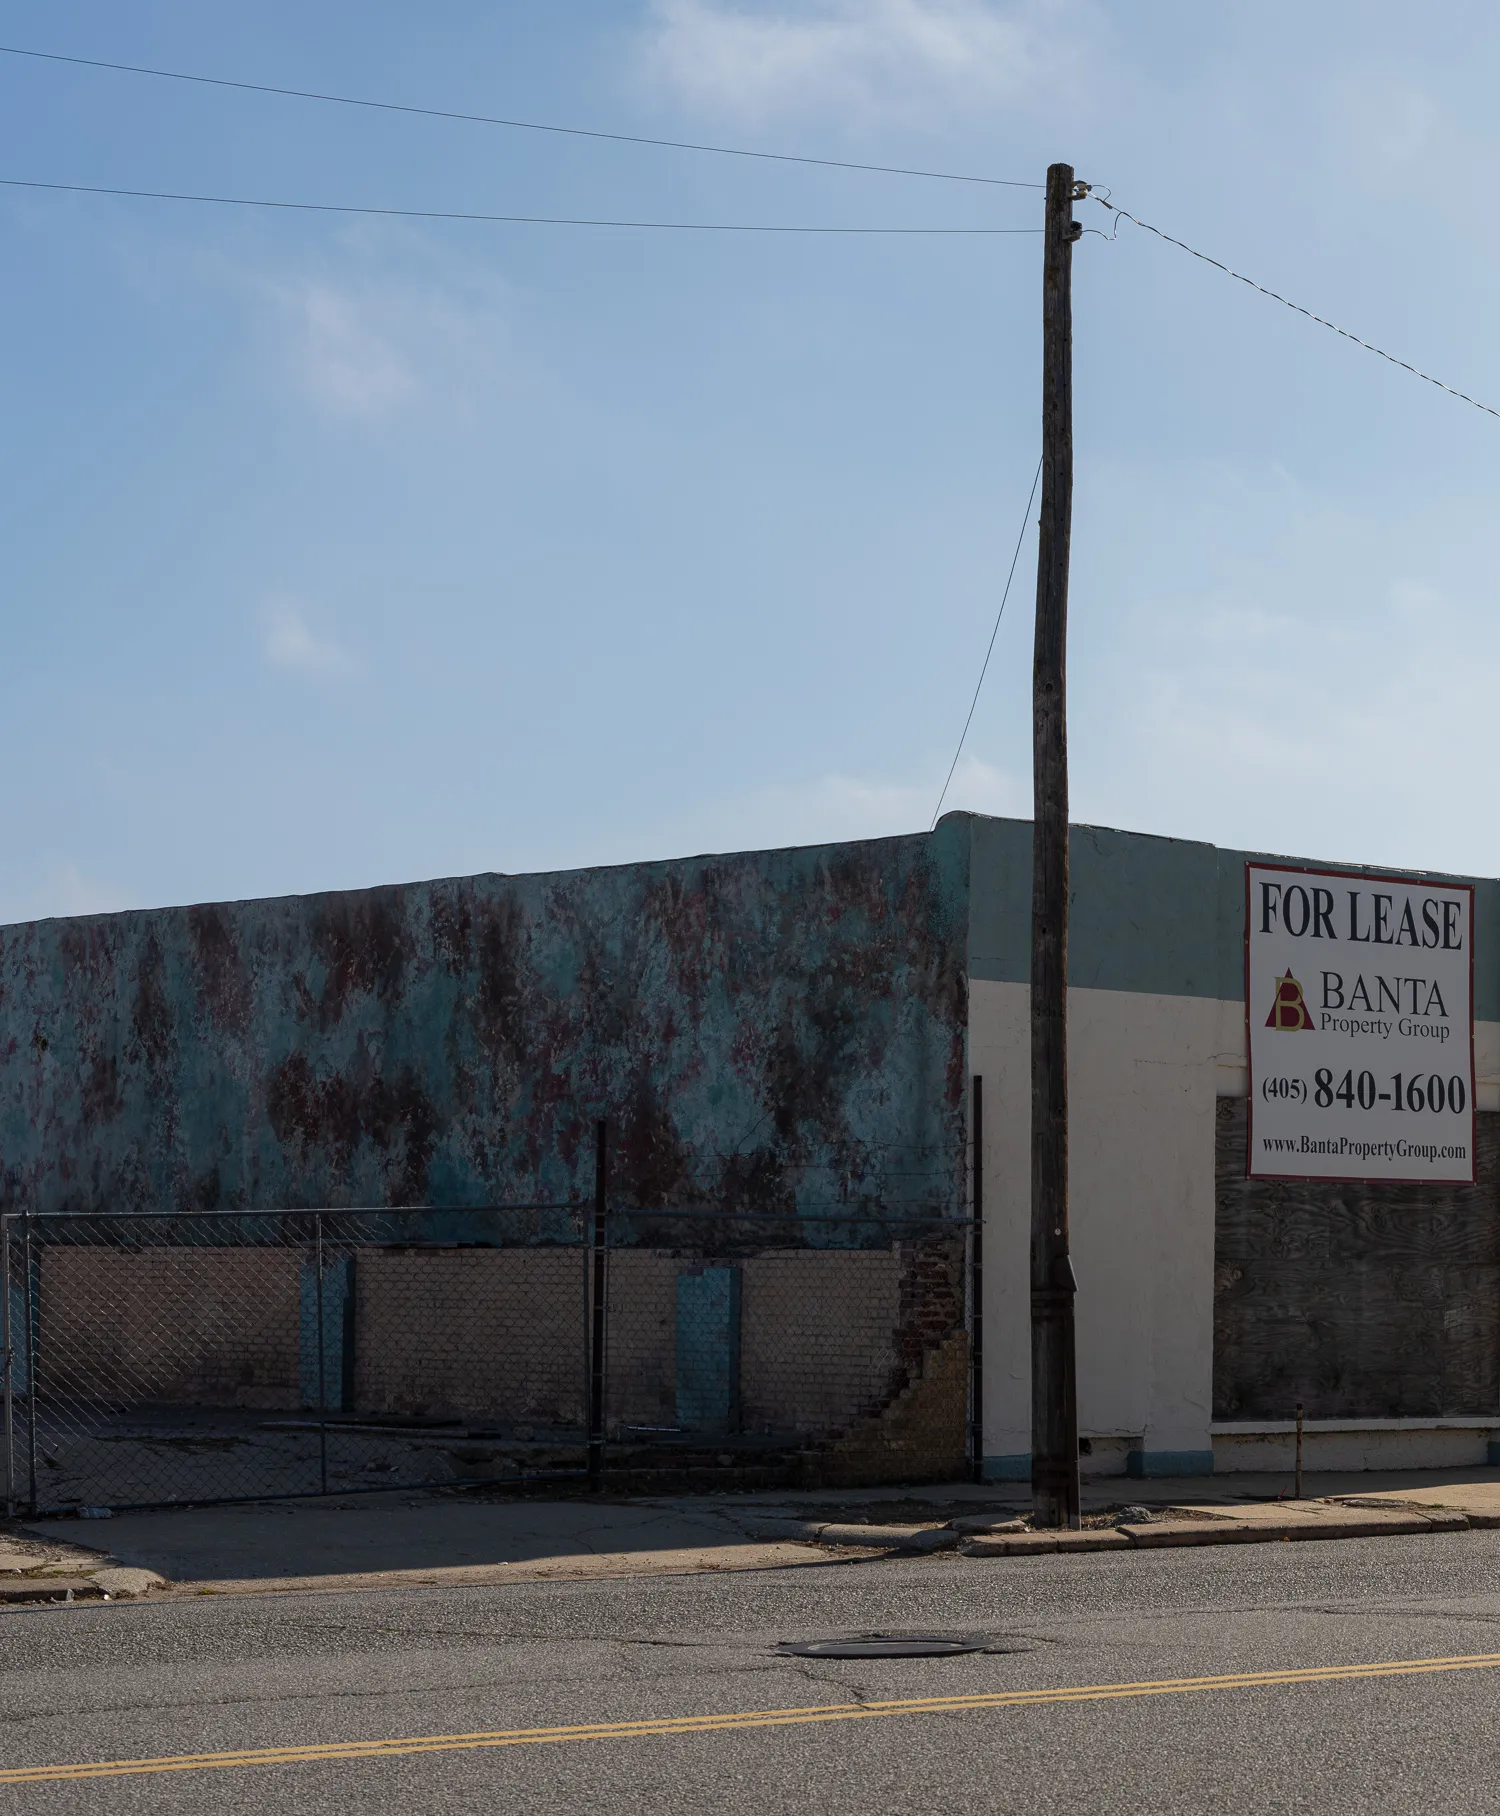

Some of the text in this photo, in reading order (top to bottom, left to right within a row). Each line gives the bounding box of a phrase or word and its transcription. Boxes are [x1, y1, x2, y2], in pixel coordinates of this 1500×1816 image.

[1259, 881, 1463, 950] FOR LEASE
[1319, 970, 1449, 1017] BANTA
[1320, 1012, 1450, 1043] Property Group
[1262, 1067, 1466, 1114] (405) 840-1600
[1263, 1135, 1467, 1162] www.BantaPropertyGroup.com
